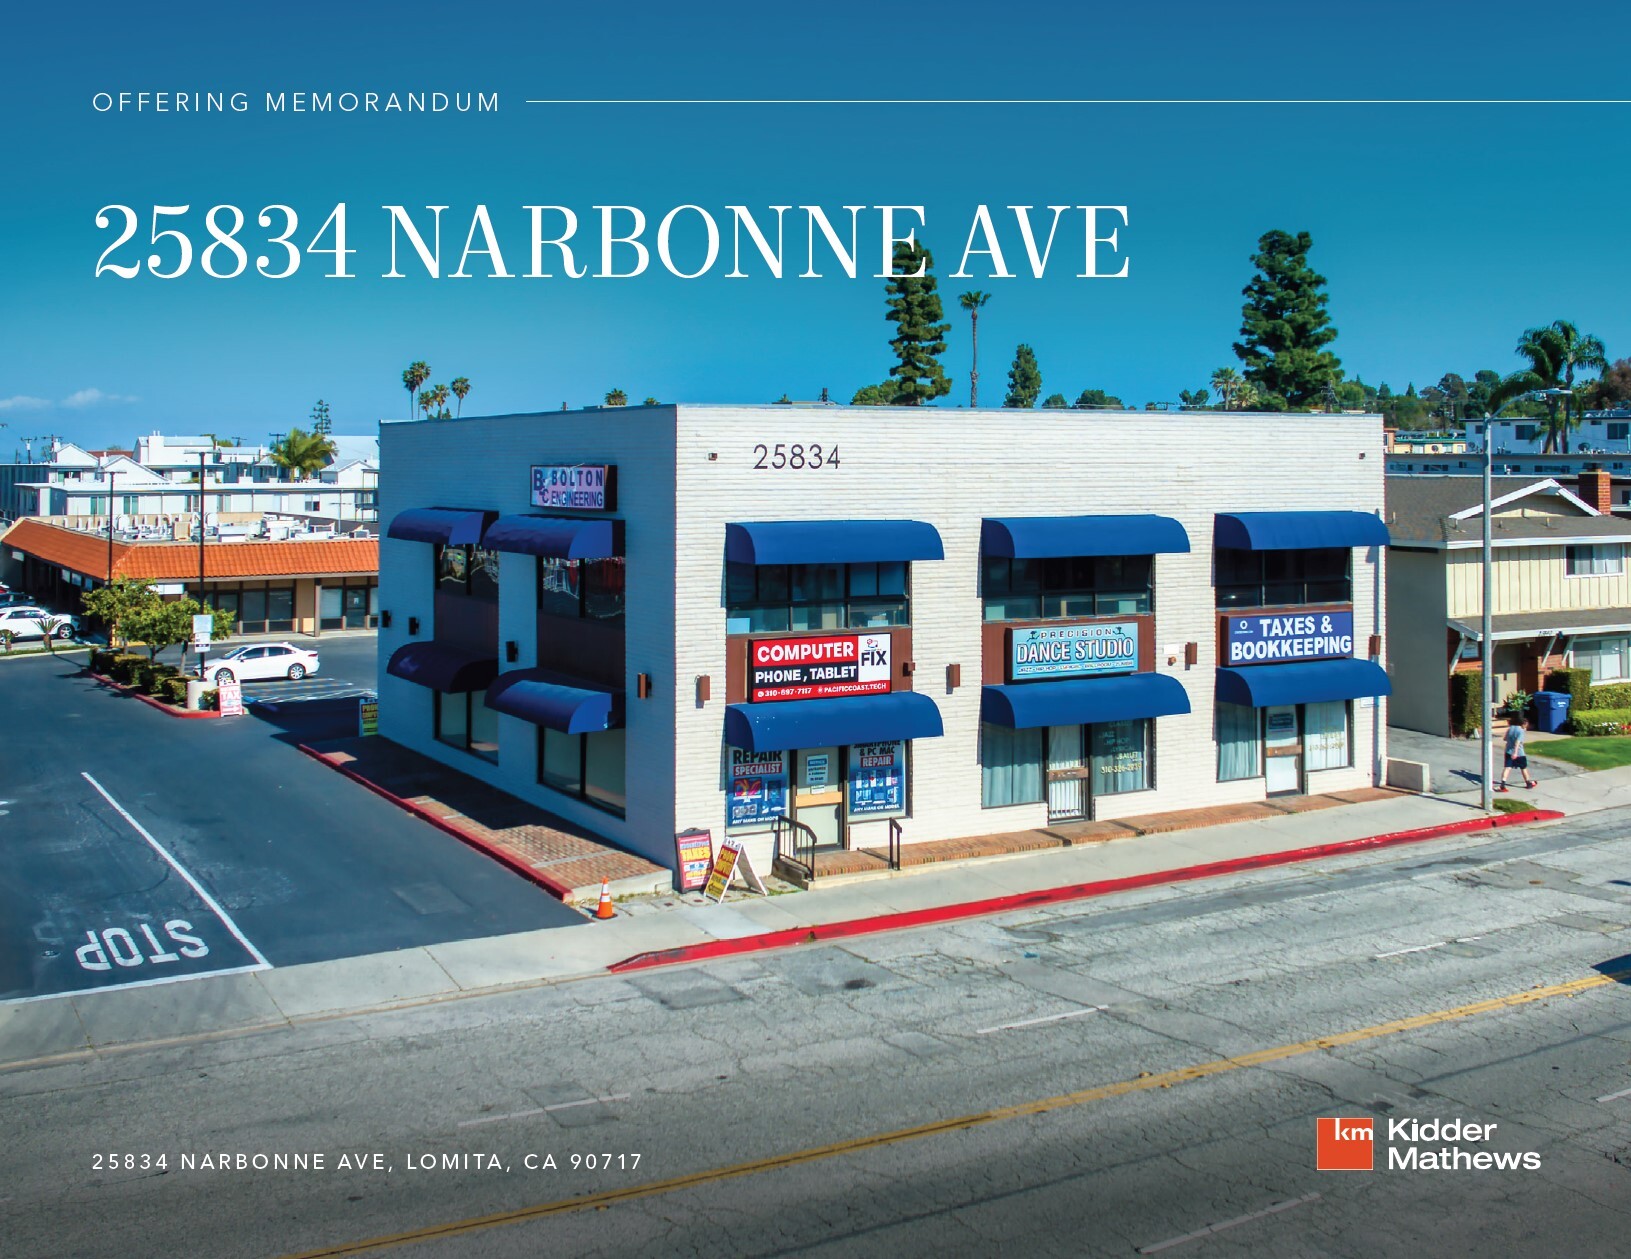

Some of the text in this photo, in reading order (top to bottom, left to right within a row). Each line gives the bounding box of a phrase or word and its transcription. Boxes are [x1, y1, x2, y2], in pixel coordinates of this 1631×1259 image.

[753, 444, 841, 470] 25834
[551, 469, 603, 486] BOLTON
[551, 491, 603, 507] ENGINEERING
[1040, 628, 1112, 639] PRECISION
[1259, 615, 1334, 638] TAXES &
[757, 641, 854, 662] COMPUTER
[1016, 637, 1135, 665] DANCE STUDIO
[1231, 635, 1352, 660] BOOKKEEPING
[861, 650, 887, 666] FIX
[809, 666, 857, 680] TABLET
[734, 763, 781, 777] SPECIALIST
[862, 756, 892, 767] REPAIR
[76, 920, 209, 970] STOP
